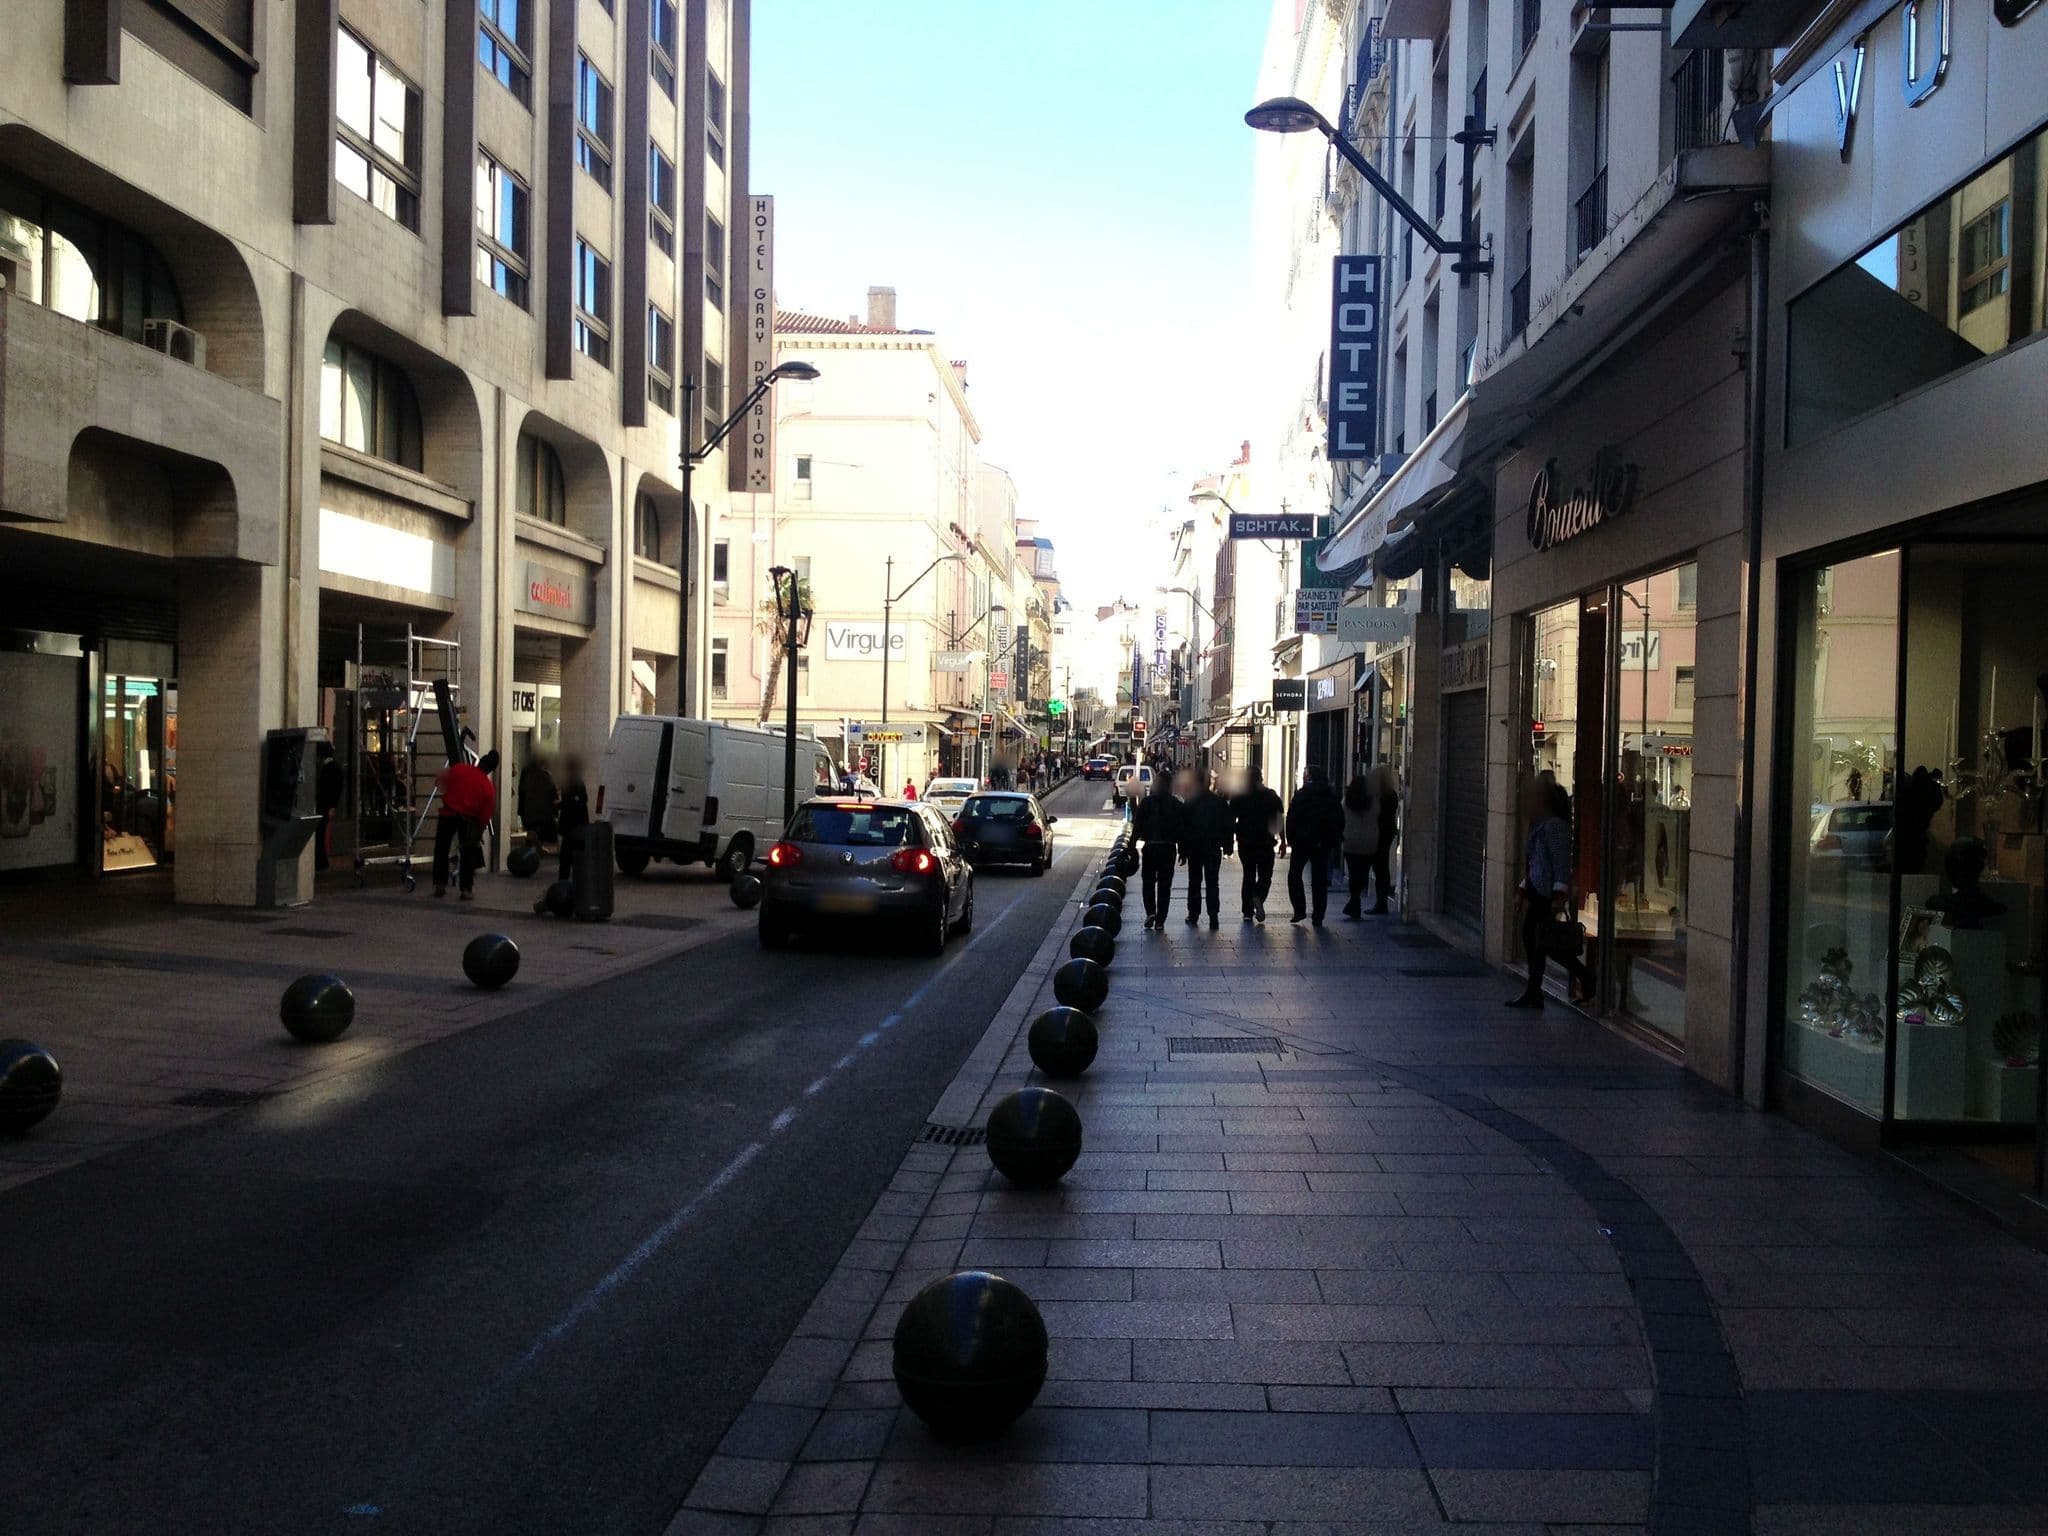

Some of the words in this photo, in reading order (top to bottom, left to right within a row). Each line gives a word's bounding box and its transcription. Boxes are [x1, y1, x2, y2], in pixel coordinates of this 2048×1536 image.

[755, 200, 767, 271] HOTEL
[755, 289, 766, 343] GRAY
[1338, 263, 1375, 451] HOTEL
[753, 361, 768, 459] D'ABION
[1297, 601, 1309, 611] PAR
[1344, 620, 1397, 630] PANDORA
[828, 628, 904, 654] Virgue
[868, 732, 903, 743] OUVERT
